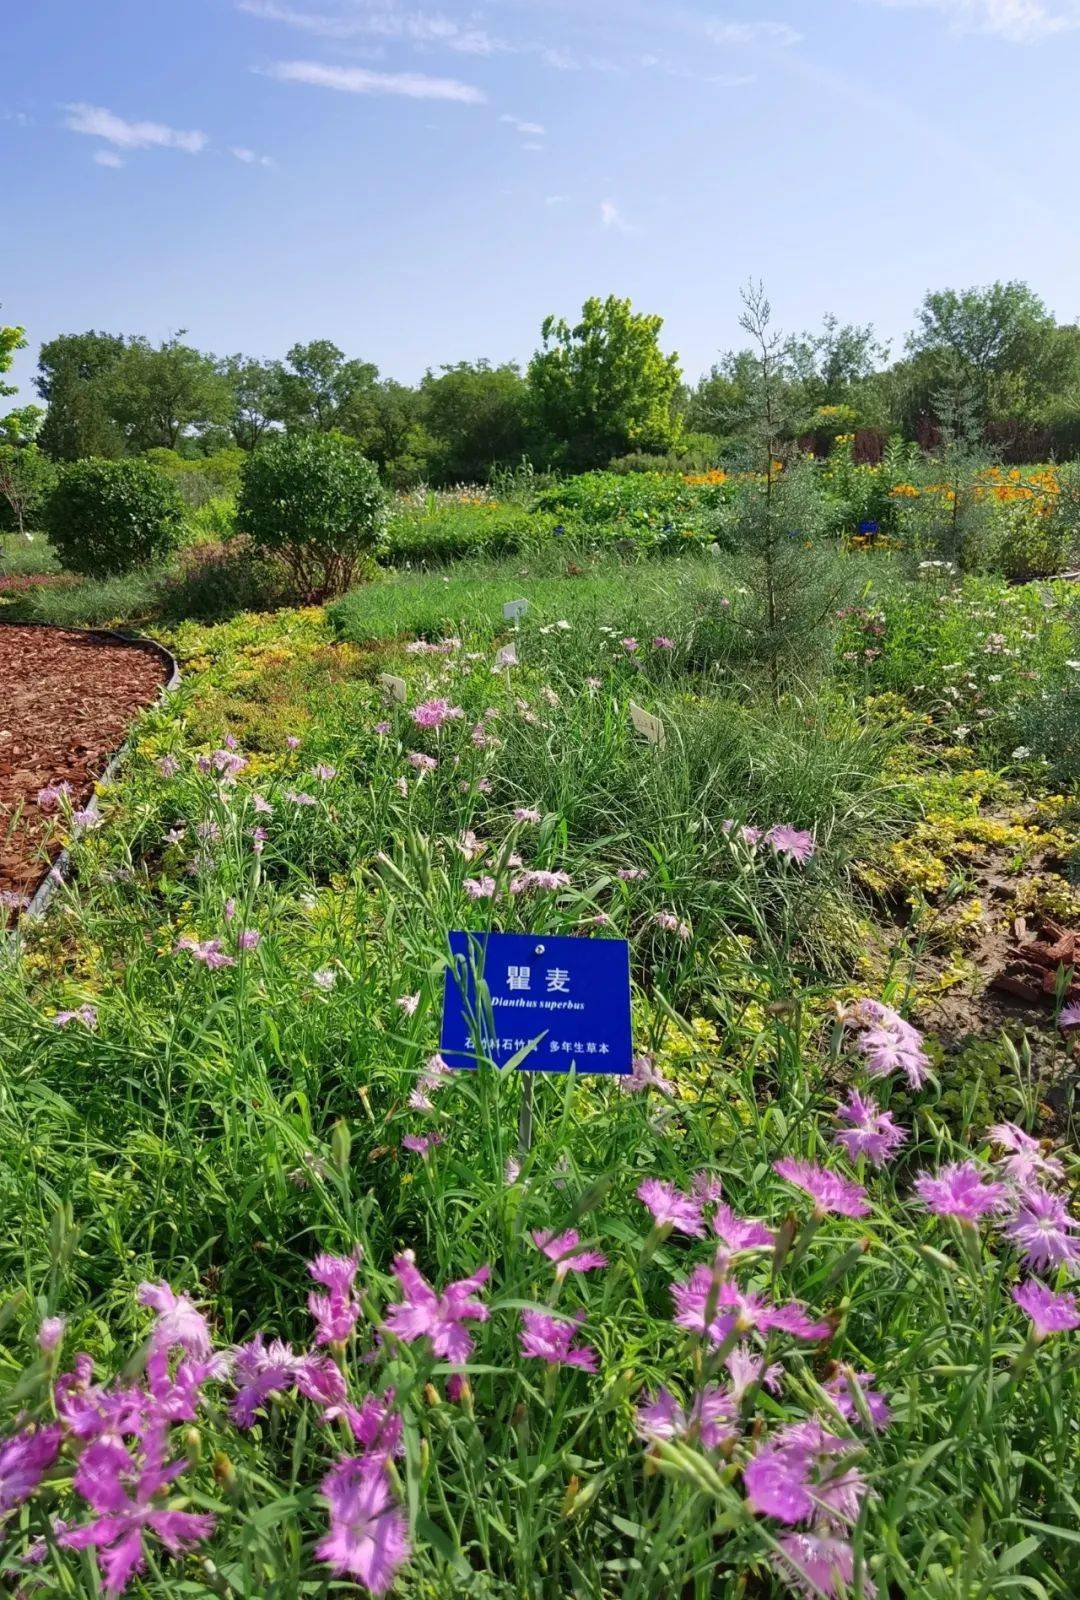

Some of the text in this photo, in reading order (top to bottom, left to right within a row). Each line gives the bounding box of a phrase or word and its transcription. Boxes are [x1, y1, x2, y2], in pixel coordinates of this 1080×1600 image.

[506, 965, 571, 993] 瞿麦
[491, 996, 585, 1010] Dianthus superbus
[549, 1041, 610, 1054] 多年生草本
